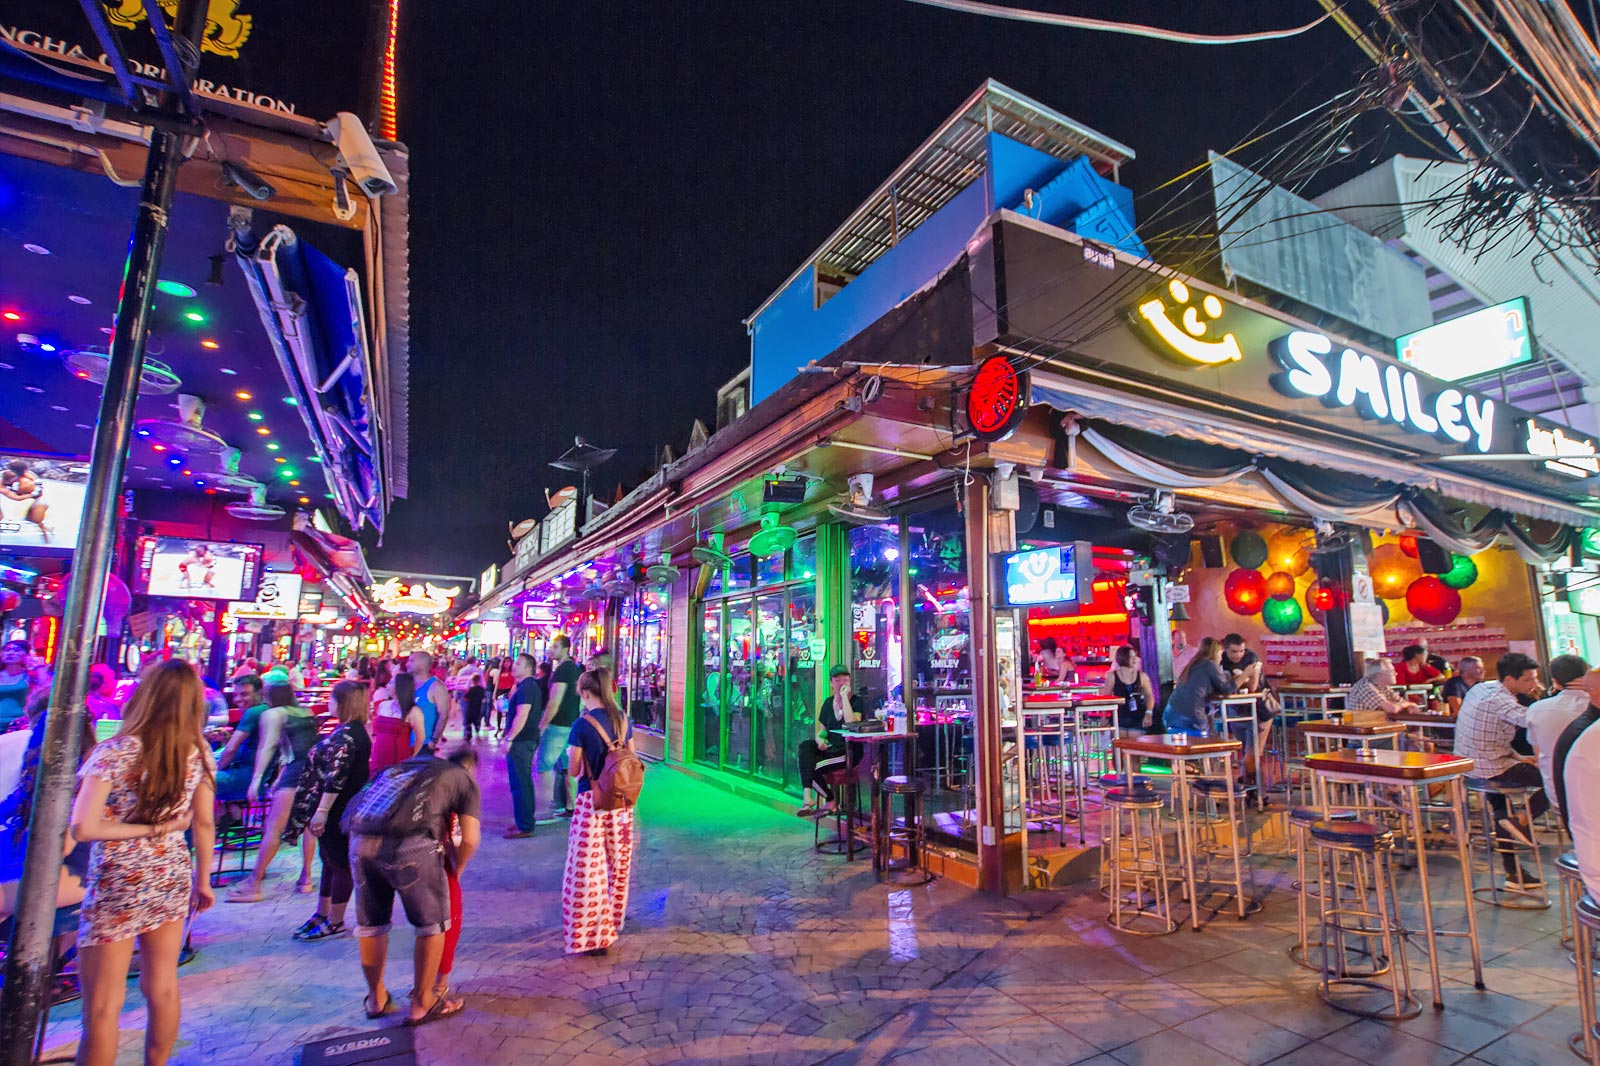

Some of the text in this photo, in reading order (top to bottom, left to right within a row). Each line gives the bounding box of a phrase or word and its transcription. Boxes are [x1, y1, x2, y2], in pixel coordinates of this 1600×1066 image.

[1287, 331, 1495, 452] SMILEY
[859, 660, 881, 669] SMILEY
[931, 660, 960, 669] SMILEY
